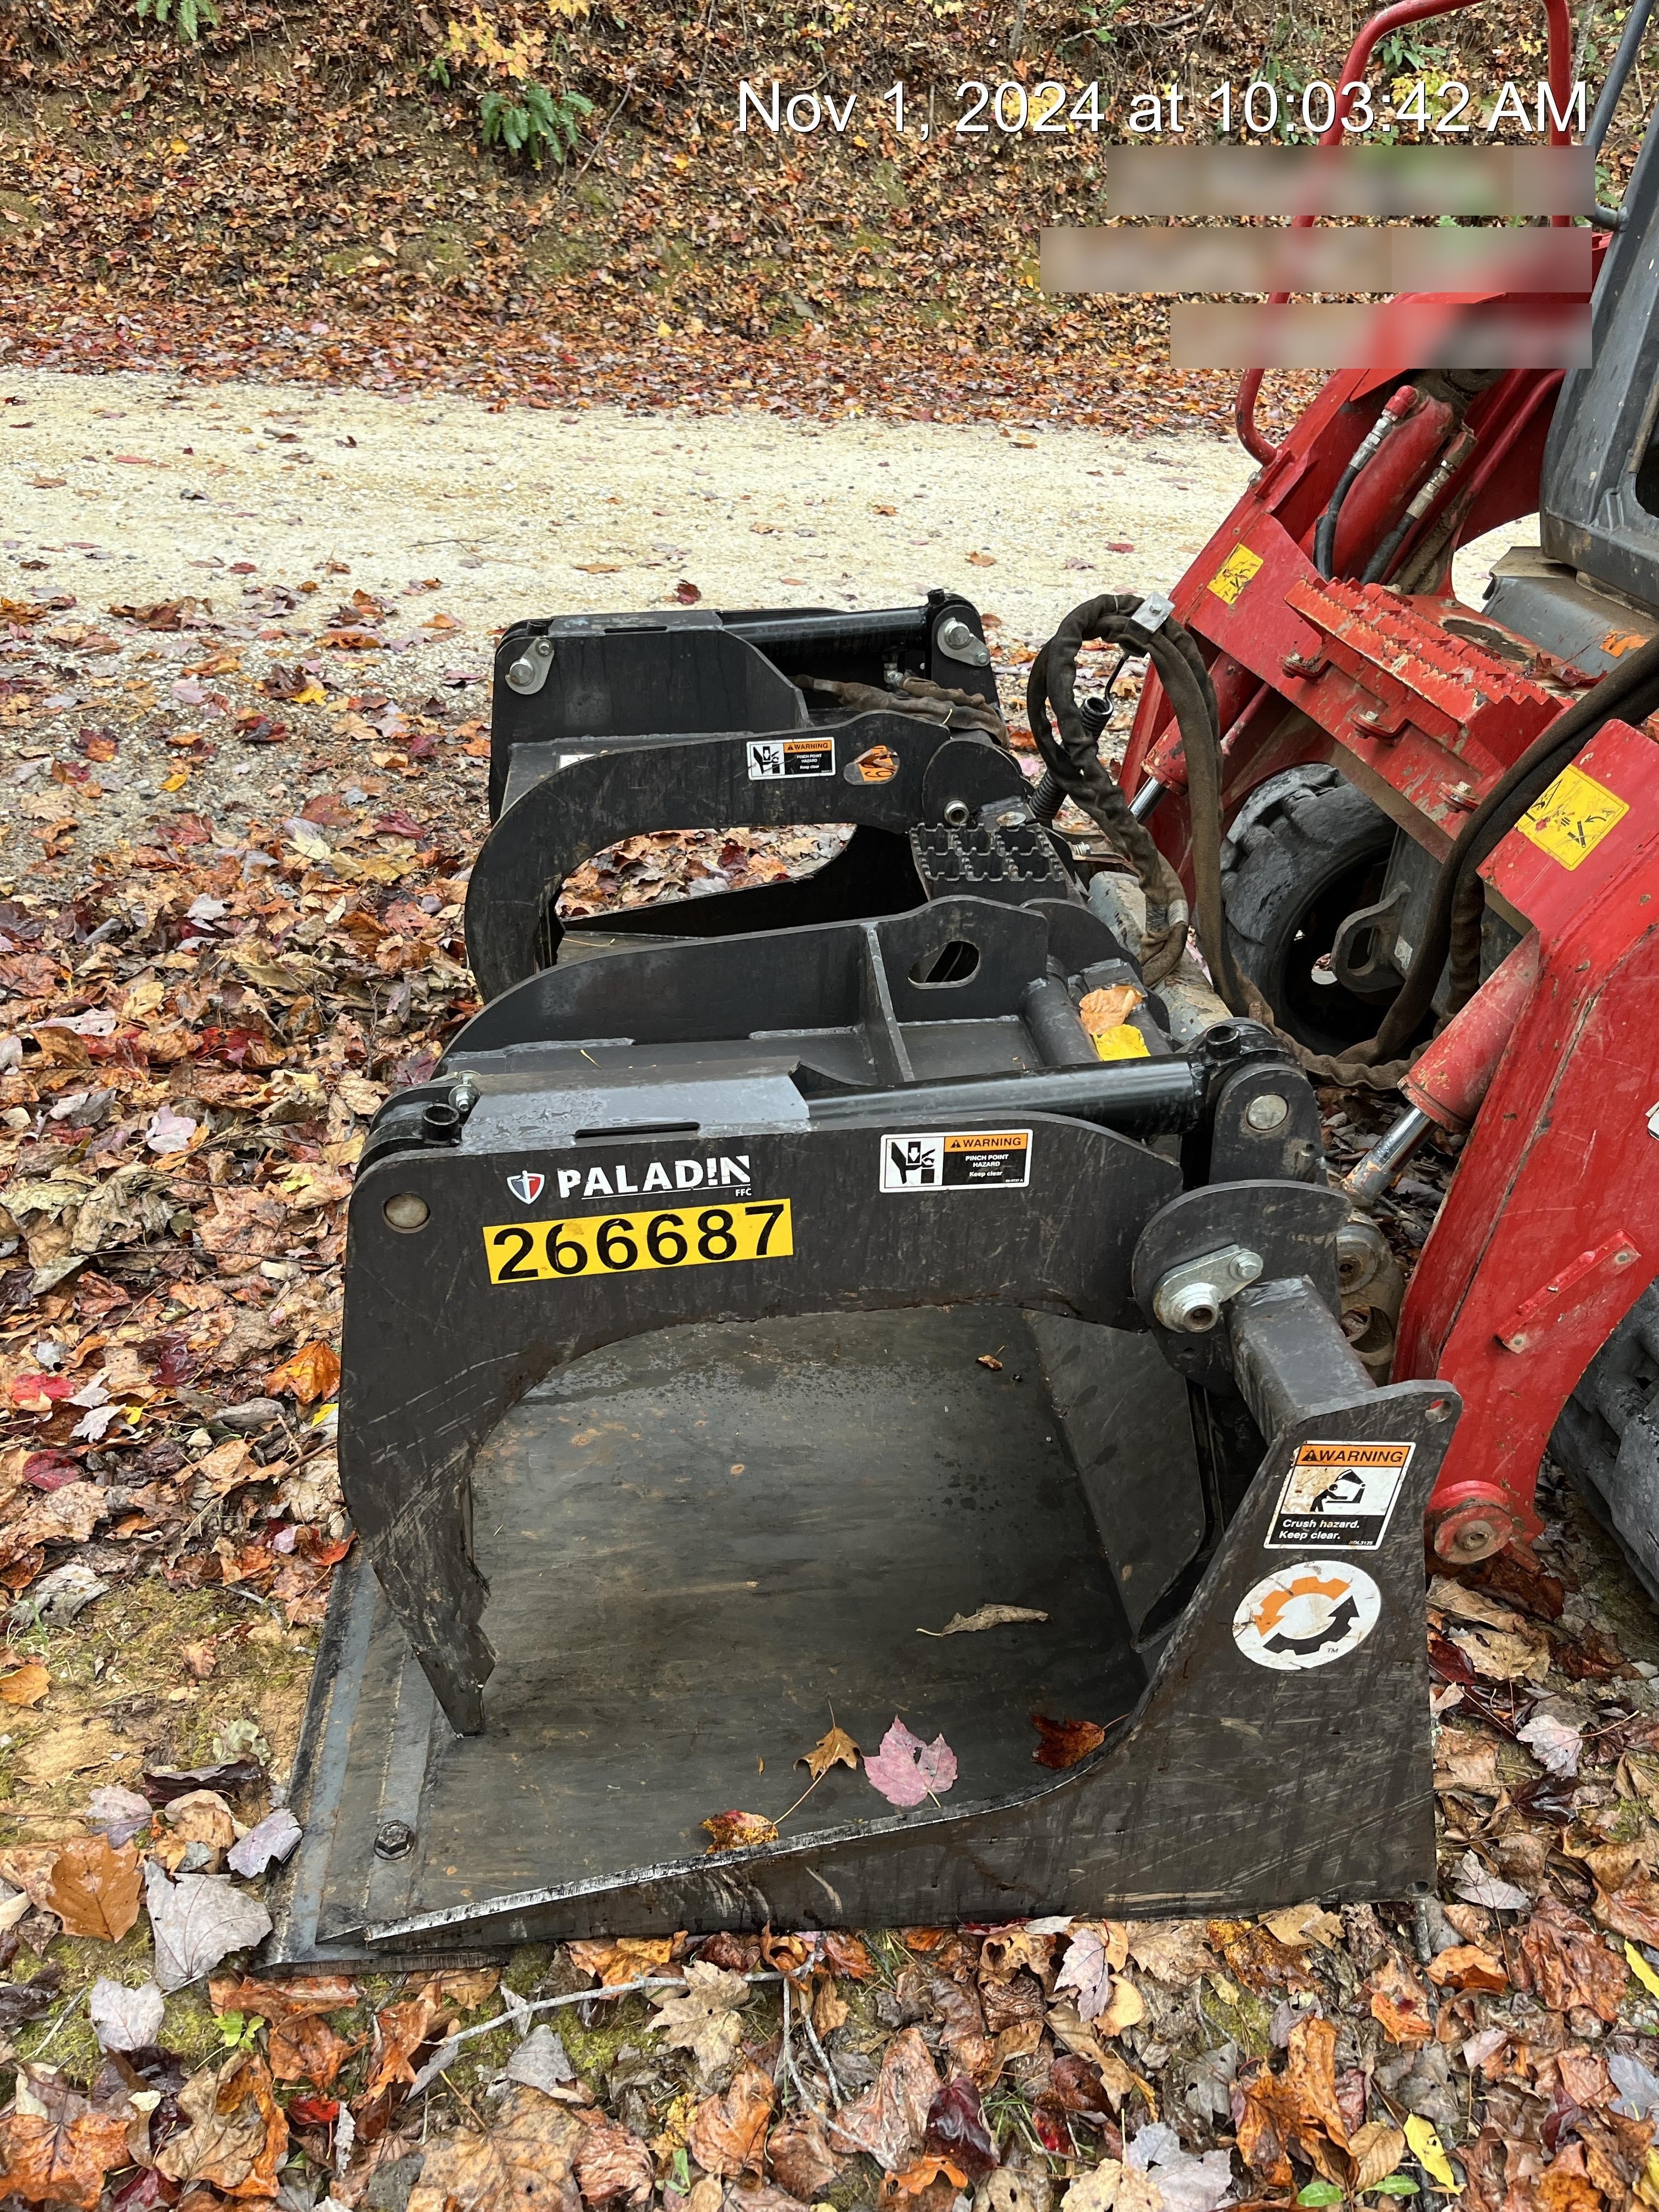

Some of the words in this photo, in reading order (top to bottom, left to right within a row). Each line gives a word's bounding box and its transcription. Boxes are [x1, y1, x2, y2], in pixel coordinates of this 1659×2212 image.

[963, 1137, 1021, 1148] WARNING
[557, 1155, 751, 1198] PALADIN
[735, 1188, 752, 1197] FFC
[493, 1204, 785, 1281] 266687
[1319, 1450, 1403, 1463] WARNING
[1283, 1519, 1317, 1528] Crush
[1319, 1520, 1360, 1528] hazard.
[1279, 1530, 1308, 1541] Keep
[1310, 1531, 1340, 1539] clear.
